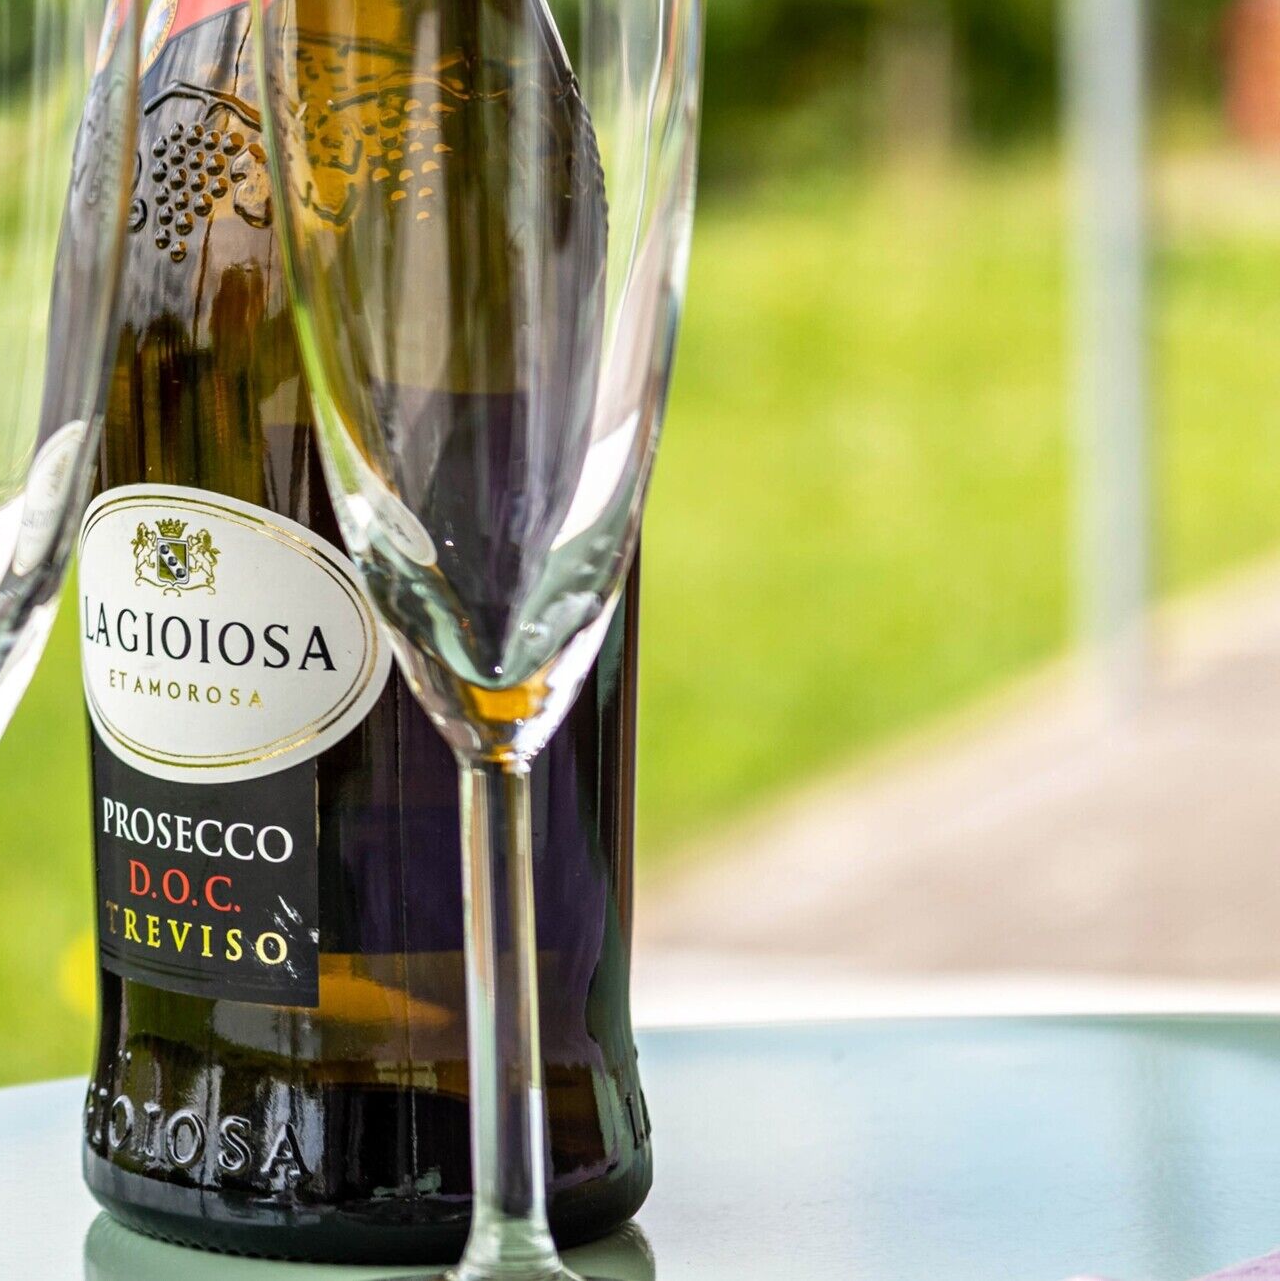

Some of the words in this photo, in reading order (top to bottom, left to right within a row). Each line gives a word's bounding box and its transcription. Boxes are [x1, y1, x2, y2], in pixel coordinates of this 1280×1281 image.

[102, 796, 294, 863] PROSECCO
[128, 859, 242, 913] D.O.C.
[106, 899, 289, 965] TREVISO
